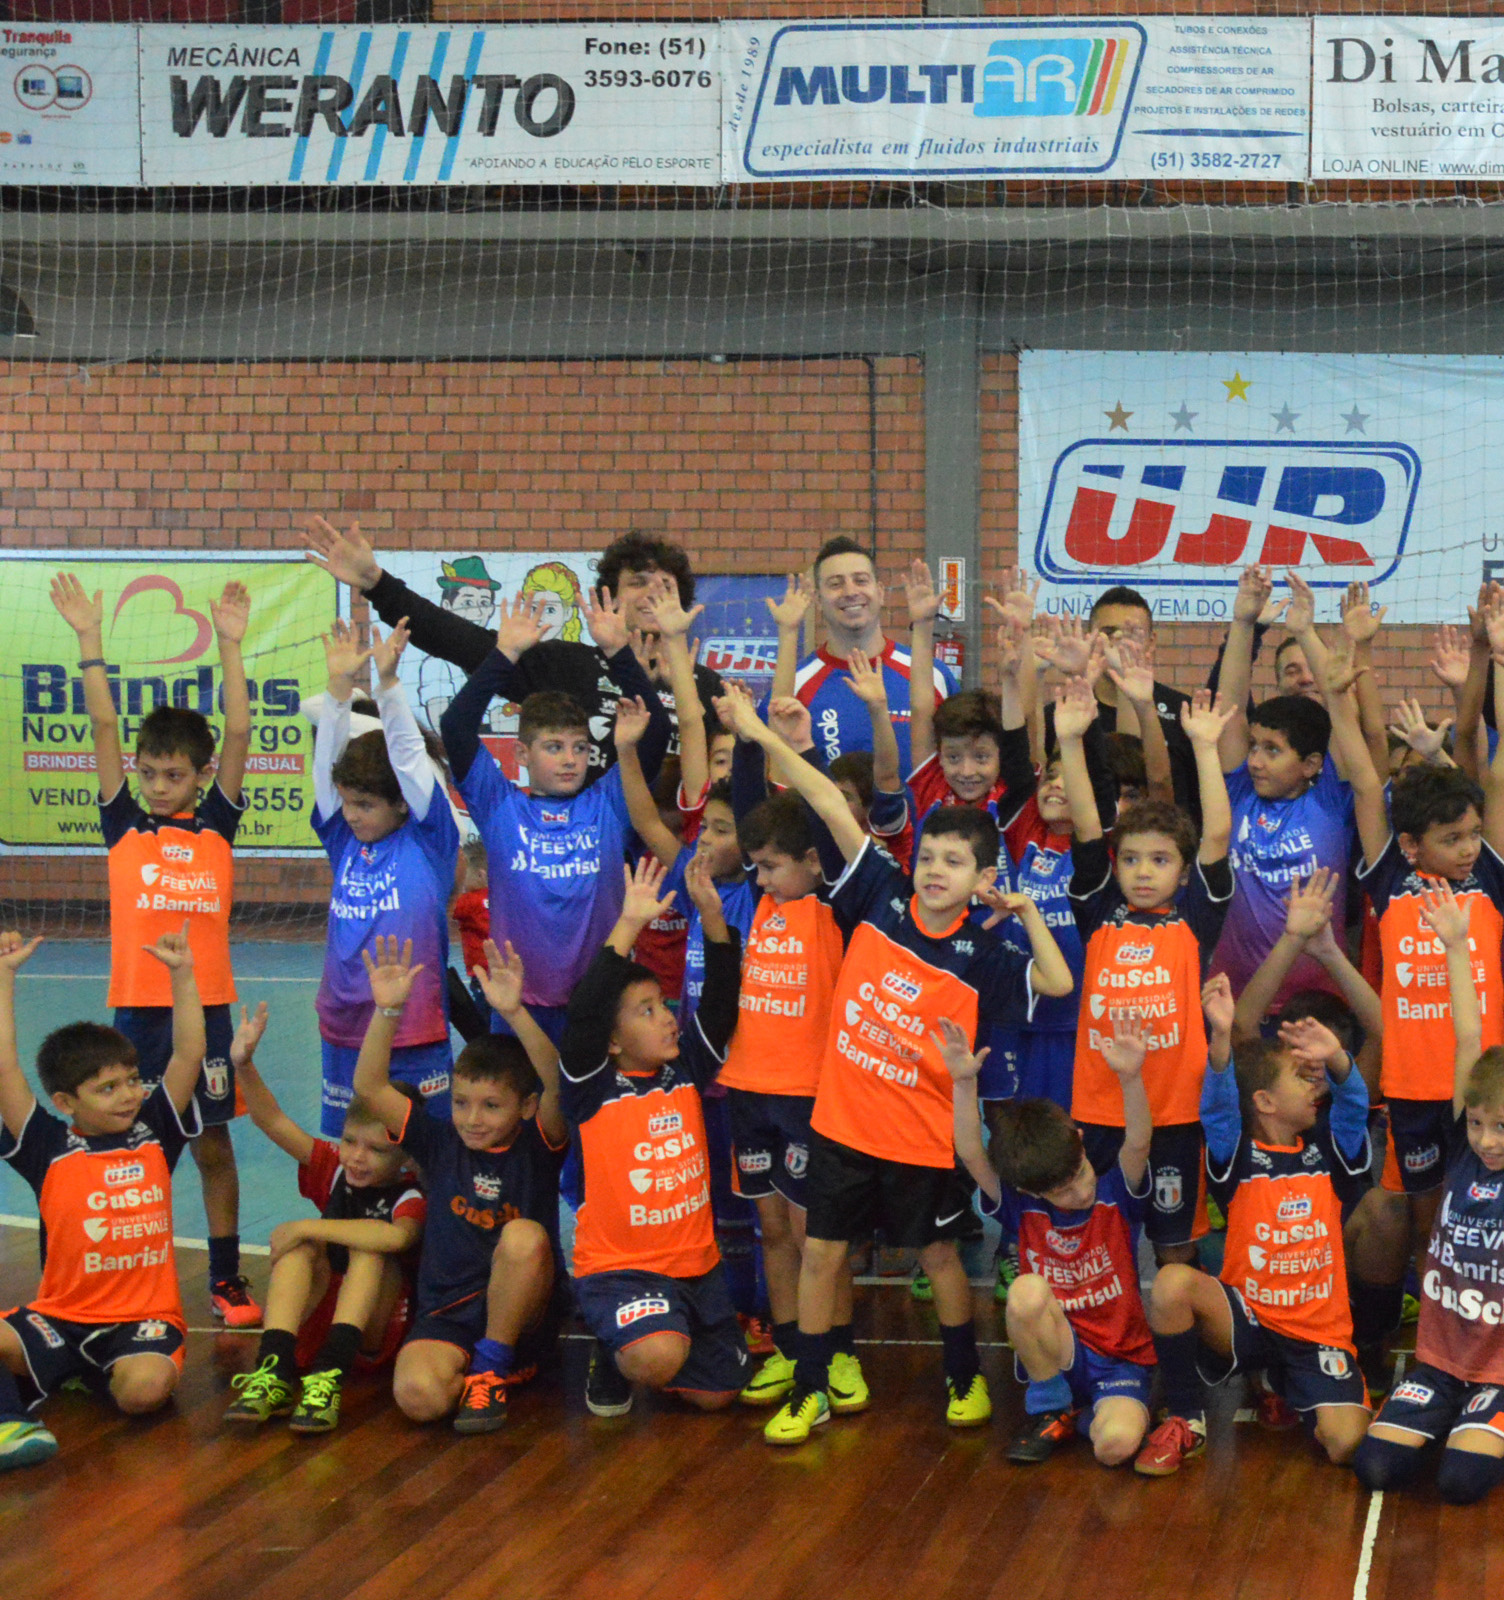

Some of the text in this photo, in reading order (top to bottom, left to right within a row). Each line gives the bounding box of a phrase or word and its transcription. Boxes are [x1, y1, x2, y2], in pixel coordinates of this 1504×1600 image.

[3, 29, 73, 46] Tranquila
[1174, 24, 1268, 36] TUBOS E CONEXÕES
[167, 43, 301, 67] MECÂNICA
[585, 37, 706, 60] Fone: (51)
[1169, 44, 1273, 56] ASSISTÊNCIA TÉCNICA
[1326, 37, 1397, 83] Di
[584, 69, 713, 89] 3593-6076
[1167, 65, 1275, 76] COMPRESSORES DE AR
[727, 35, 762, 134] desde 1989
[1145, 85, 1296, 97] SECADORES DE AR COMPRIMIDO
[170, 73, 576, 138] WERANTO
[1134, 105, 1306, 118] PROJETOS E INSTALAÇÕES DE REDES
[1372, 98, 1436, 116] Bolsas,
[1371, 121, 1452, 137] vestuário
[1458, 126, 1485, 138] em
[762, 136, 1100, 160] especialista em fluidos industriais
[539, 158, 548, 168] A
[555, 155, 618, 170] EDUCAÇÃO
[622, 157, 653, 169] PELO
[1150, 151, 1282, 171] (51) 3582-2727
[1322, 159, 1363, 174] LOJA
[1367, 159, 1433, 174] ONLINE:
[1064, 465, 1387, 567] UJR
[1196, 598, 1227, 618] DO
[160, 875, 218, 891] FEEVALE
[152, 893, 221, 914] Banrisul
[746, 965, 808, 987] FEEVALE
[1097, 964, 1172, 989] GuSch
[858, 981, 926, 1038] GuSch
[859, 1018, 923, 1064] FEEVALE
[836, 1028, 919, 1089] Banrisul
[86, 1183, 164, 1211] GuSch
[111, 1218, 169, 1242] FEEVALE
[1255, 1218, 1329, 1246] GuSch
[1043, 1249, 1113, 1286] FEEVALE
[1269, 1252, 1334, 1276] FEEVALE
[1245, 1274, 1334, 1307] Banrisul
